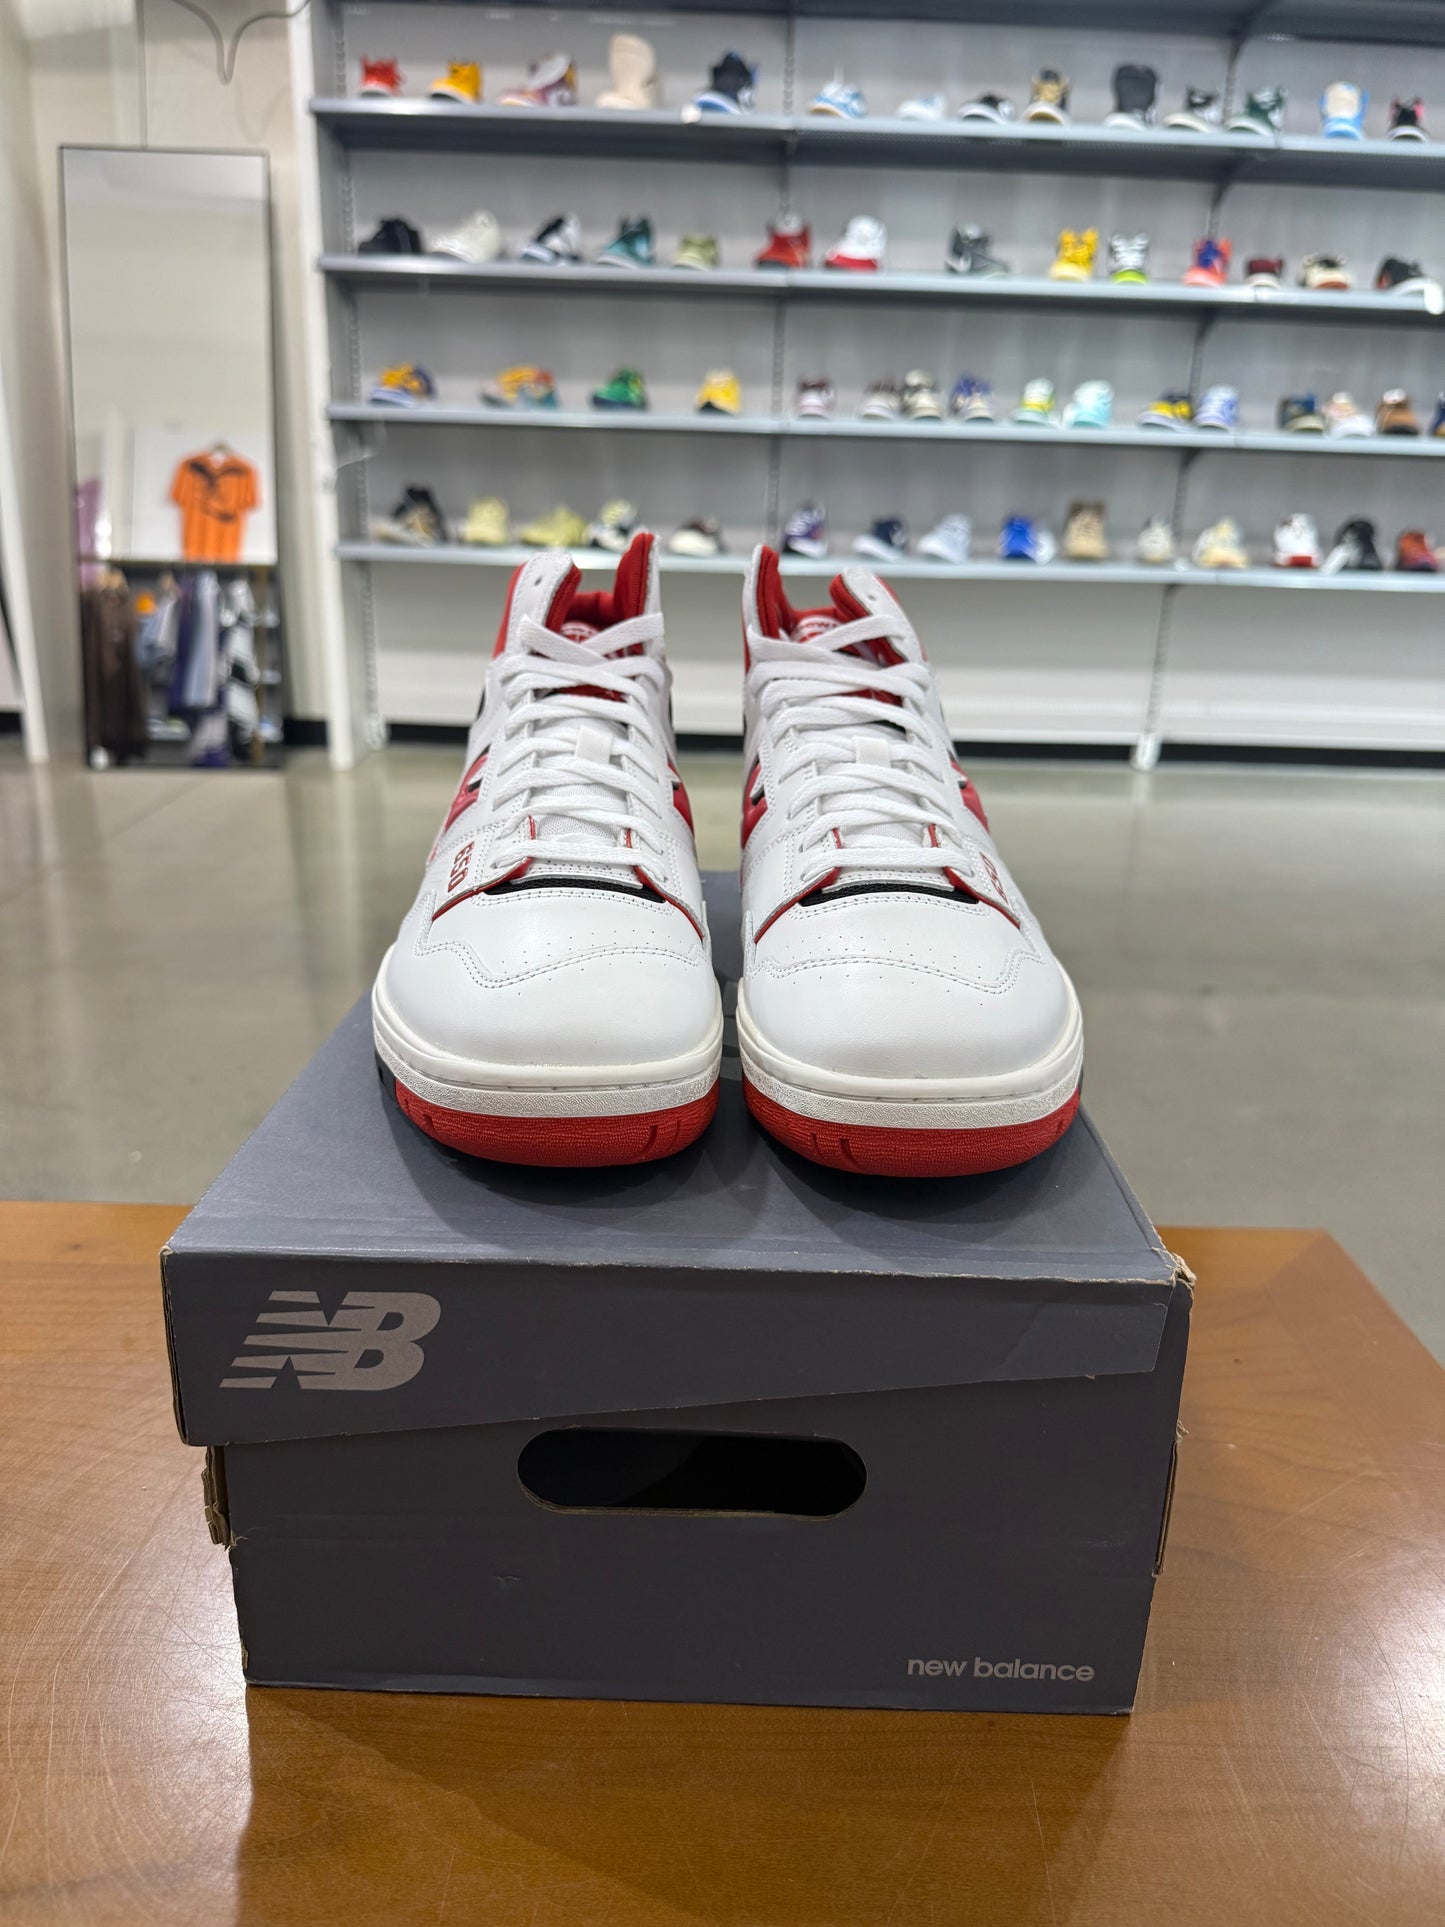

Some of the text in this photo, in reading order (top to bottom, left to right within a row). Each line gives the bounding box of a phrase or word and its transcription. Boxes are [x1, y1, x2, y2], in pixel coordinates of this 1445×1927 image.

[447, 841, 475, 893] 650
[219, 1290, 441, 1391] NB
[907, 1656, 1096, 1682] new balance
